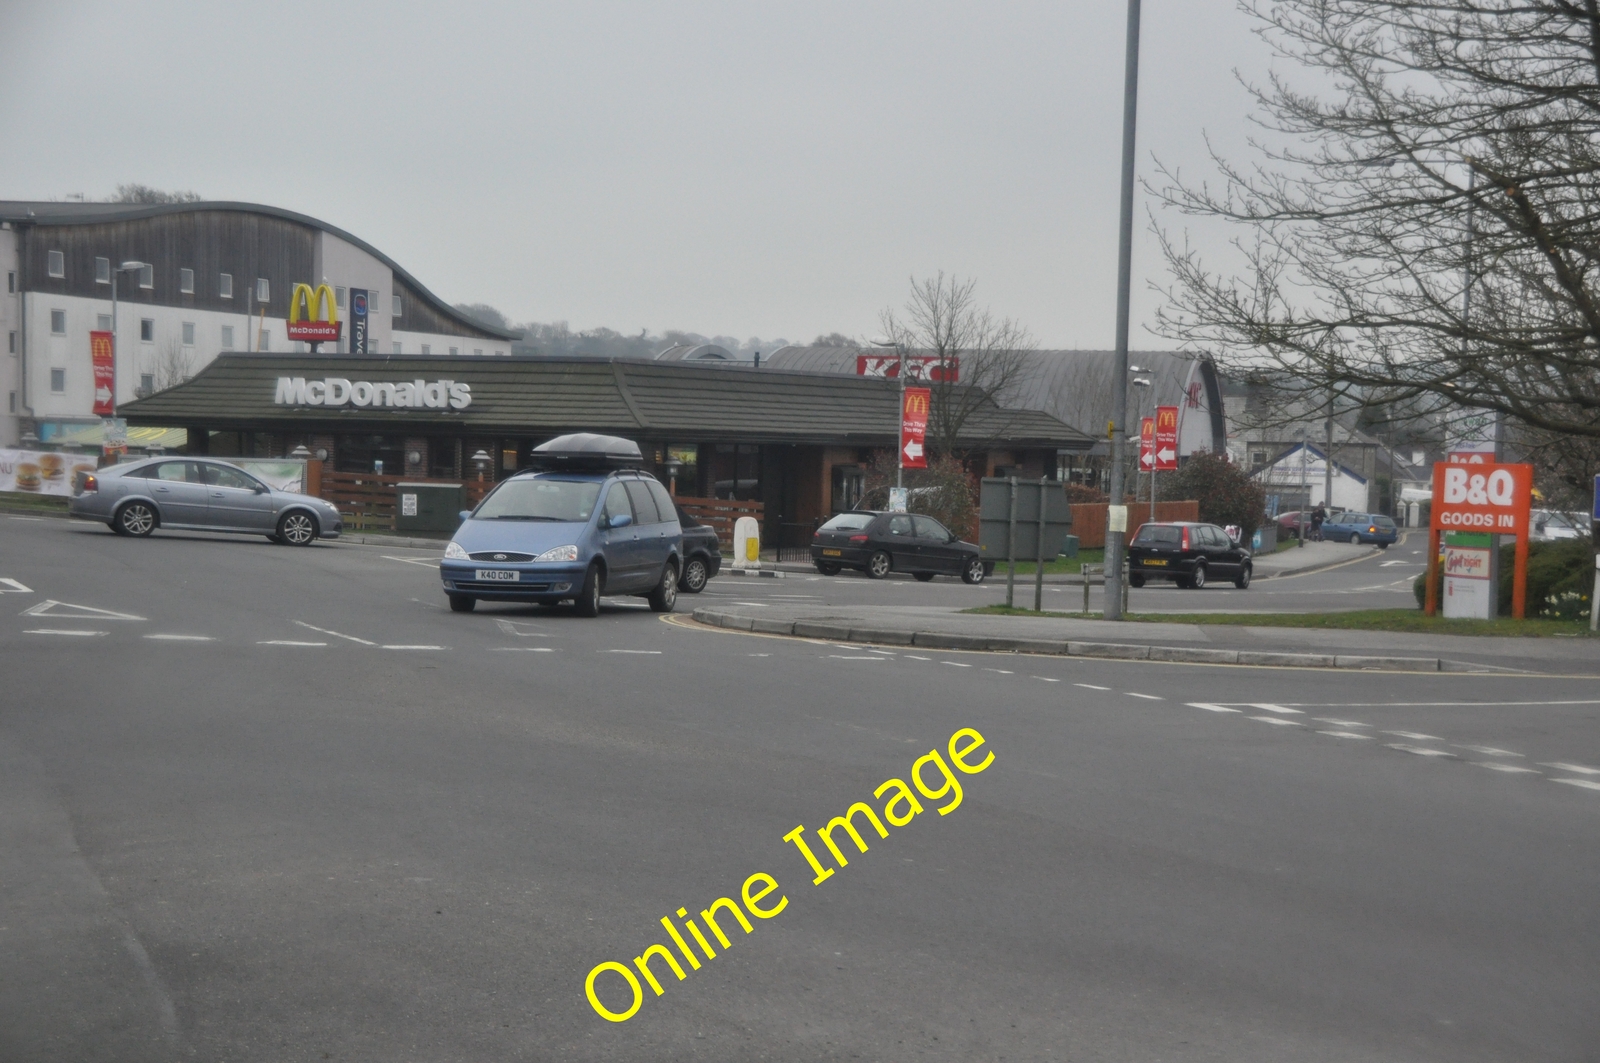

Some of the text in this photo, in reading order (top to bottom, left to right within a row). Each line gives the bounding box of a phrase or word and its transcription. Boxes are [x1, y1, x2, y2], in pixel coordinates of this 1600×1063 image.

[289, 326, 336, 335] McDonald's
[863, 358, 957, 381] KFC
[274, 376, 472, 409] McDonald's
[1443, 467, 1514, 506] B&Q
[1440, 511, 1514, 528] GOODS IN
